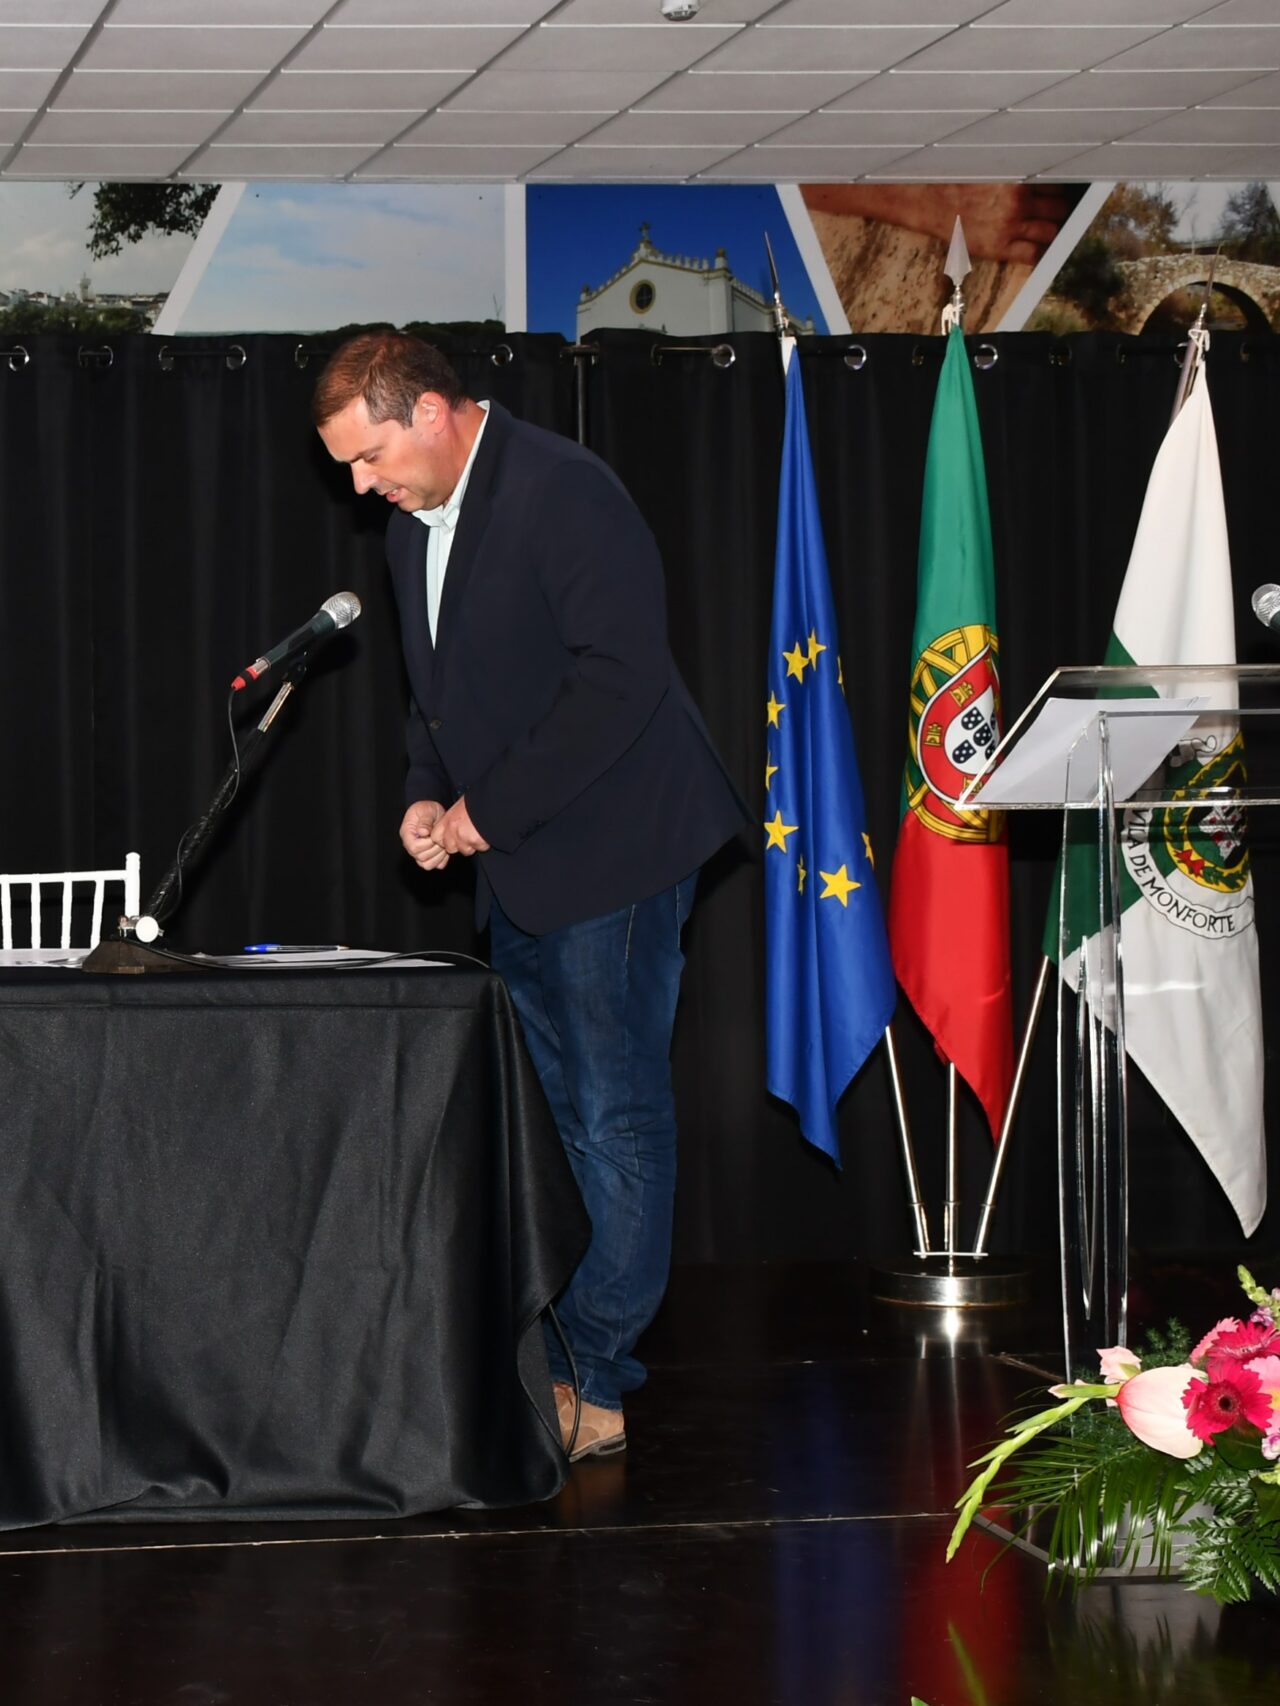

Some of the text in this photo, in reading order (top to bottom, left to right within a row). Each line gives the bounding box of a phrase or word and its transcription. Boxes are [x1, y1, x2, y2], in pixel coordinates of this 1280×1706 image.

[1128, 809, 1235, 933] VILA DE MONFORTE
